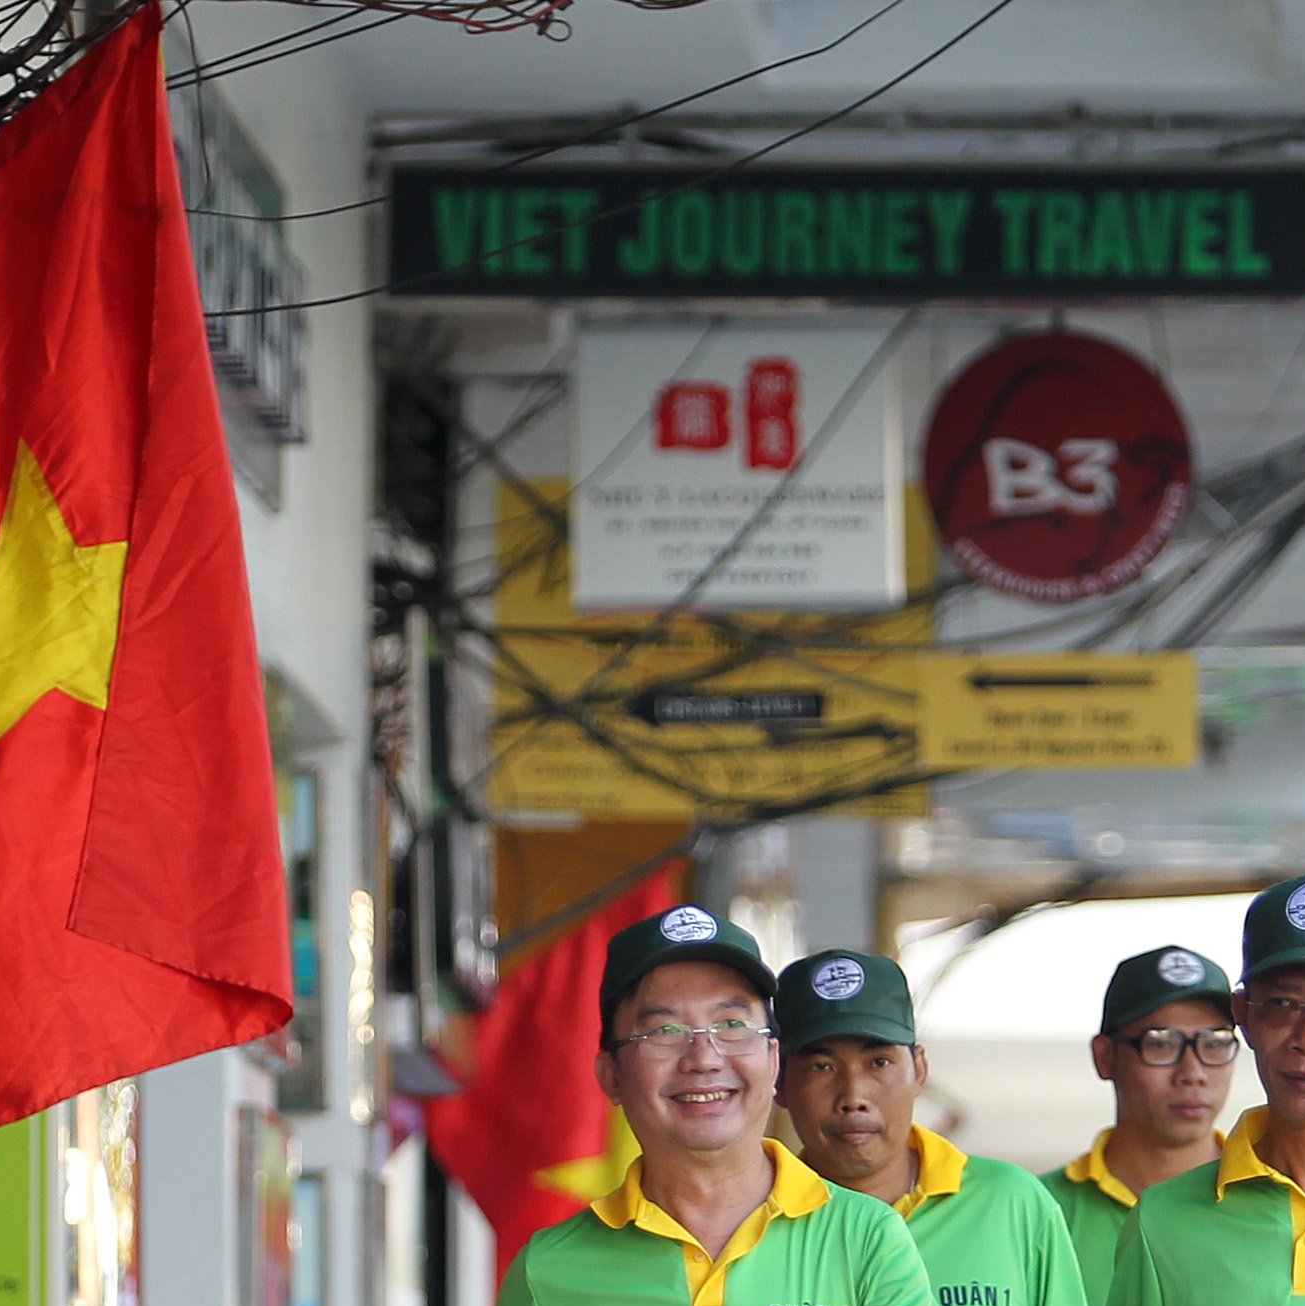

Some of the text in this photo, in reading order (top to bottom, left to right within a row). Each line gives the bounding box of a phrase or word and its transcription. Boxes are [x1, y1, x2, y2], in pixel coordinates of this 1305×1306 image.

[433, 186, 1274, 277] VIET JOURNEY TRAVEL
[981, 437, 1120, 516] B3
